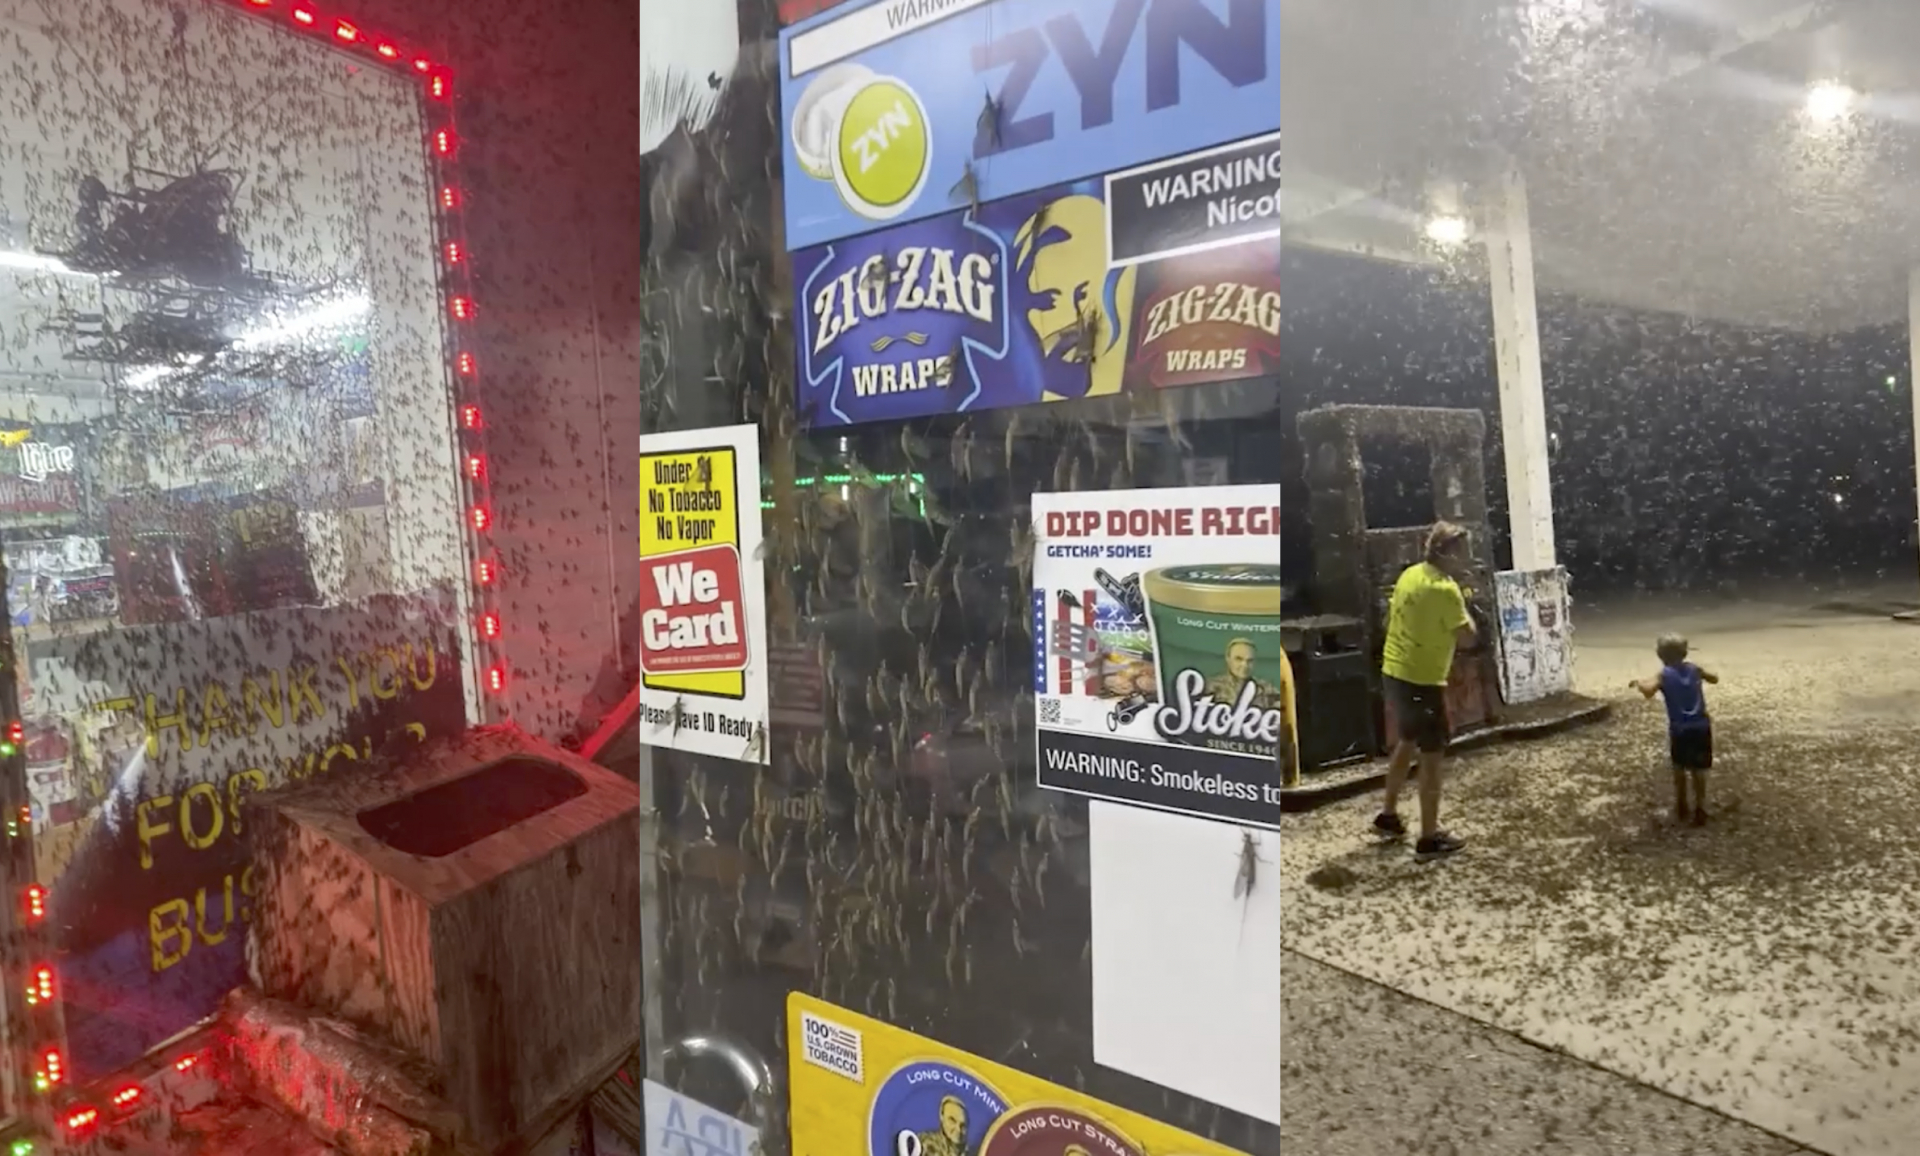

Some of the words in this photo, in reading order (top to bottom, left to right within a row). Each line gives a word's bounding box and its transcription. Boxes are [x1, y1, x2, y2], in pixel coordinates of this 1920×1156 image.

[886, 0, 966, 30] WARN
[970, 0, 1267, 159] ZYN
[851, 100, 913, 174] ZYN
[814, 247, 994, 356] ZIG-ZAG
[1142, 281, 1280, 347] ZIG-ZAG
[1167, 348, 1247, 372] WRAPS
[852, 355, 952, 397] WRAPS
[654, 459, 692, 485] Under
[649, 488, 664, 513] No
[669, 488, 721, 512] Tobacco
[657, 516, 672, 540] No
[677, 516, 716, 544] Vapor
[1047, 511, 1101, 537] DIP
[1107, 508, 1194, 536] DONE
[1047, 545, 1105, 558] GETCHA'
[1107, 545, 1152, 558] SOME!
[652, 561, 719, 607] We
[642, 601, 738, 651] Card
[1177, 616, 1204, 628] LONG
[1206, 620, 1230, 630] CUT
[84, 664, 325, 796] THANK
[338, 640, 437, 706] YOU
[1157, 669, 1280, 743] Stoke
[675, 710, 699, 731] ave
[703, 711, 714, 733] ID
[719, 714, 752, 742] Ready
[1207, 739, 1247, 752] SINCE
[1046, 748, 1145, 784] WARNING:
[1151, 764, 1258, 801] Smokeless
[805, 1018, 839, 1039] 100%
[808, 1045, 858, 1075] TOBACCO
[824, 1040, 857, 1062] GROWN
[906, 1069, 940, 1084] LONG
[943, 1070, 971, 1091] CUT
[1010, 1117, 1046, 1139] LONG
[1049, 1114, 1081, 1133] CUT
[1084, 1123, 1132, 1156] STRA
